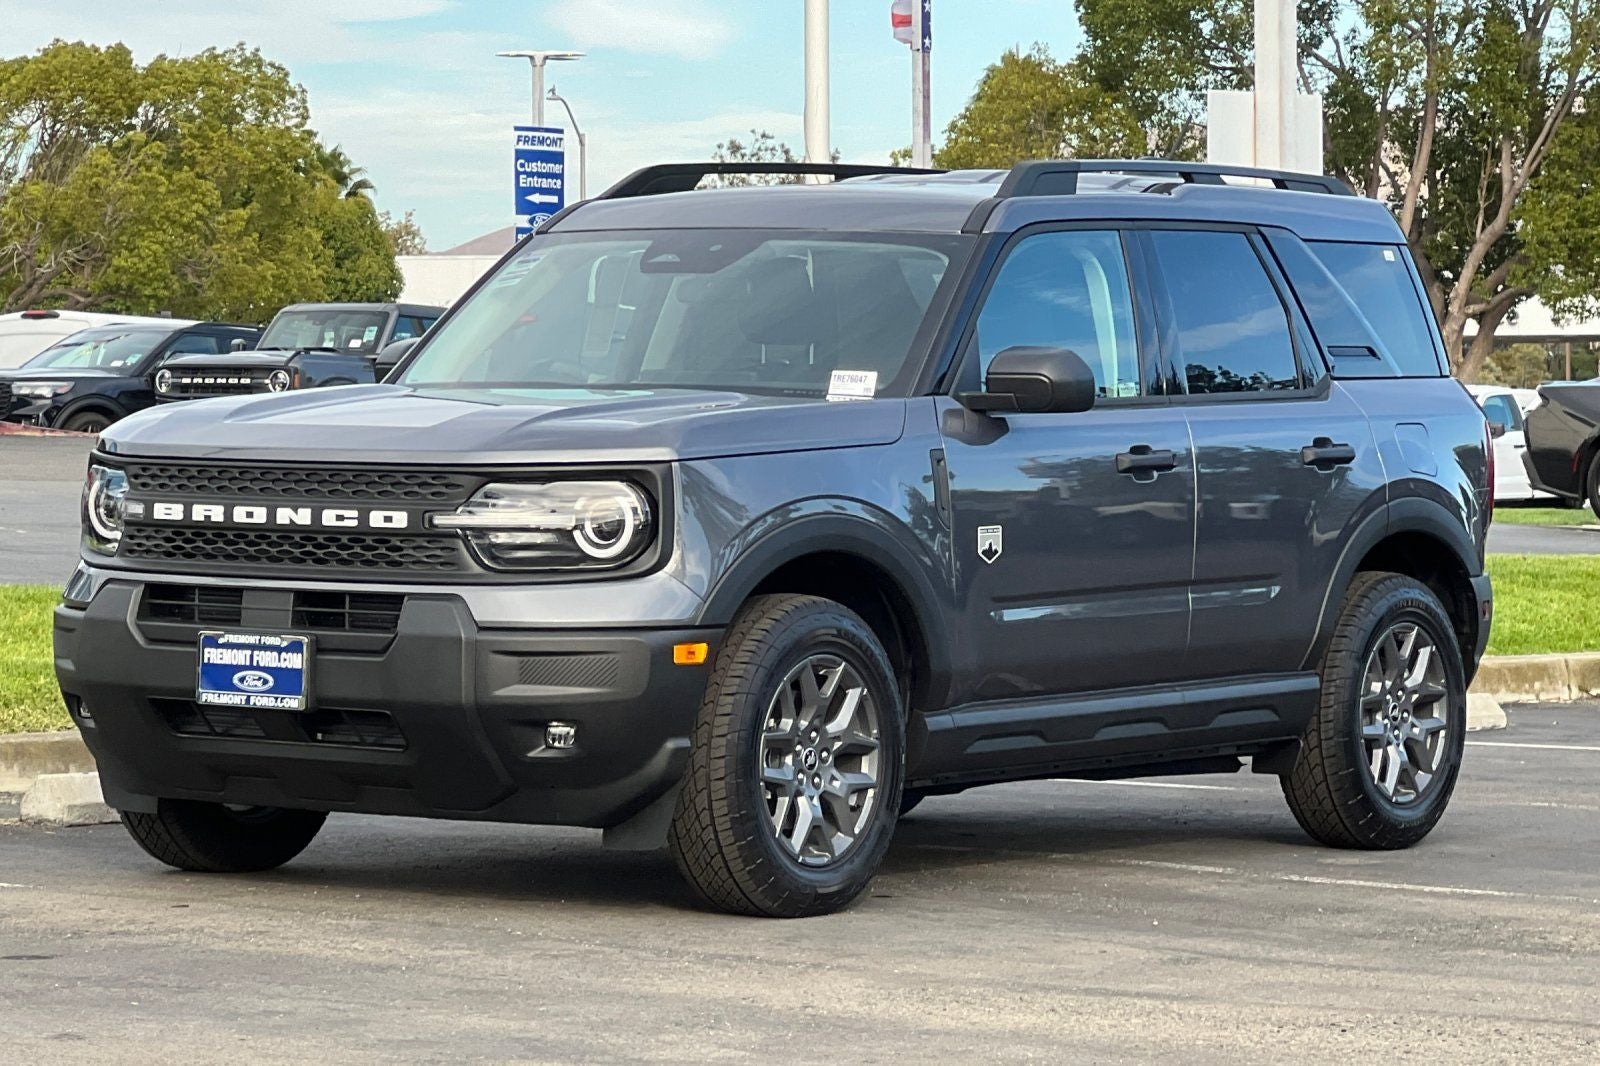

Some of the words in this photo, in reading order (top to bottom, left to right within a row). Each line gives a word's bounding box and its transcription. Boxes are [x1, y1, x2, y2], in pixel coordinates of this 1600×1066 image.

[516, 135, 563, 147] FREMONT
[517, 159, 563, 173] Customer
[520, 175, 562, 188] Entrance
[153, 502, 408, 529] BRONCO
[225, 634, 260, 644] FREMONT
[261, 636, 280, 646] FORD
[204, 648, 251, 666] FREMONT
[253, 651, 302, 669] FORD.COM
[243, 675, 264, 687] Ford
[202, 693, 247, 705] FREMONT
[250, 696, 299, 708] FORD.COM
